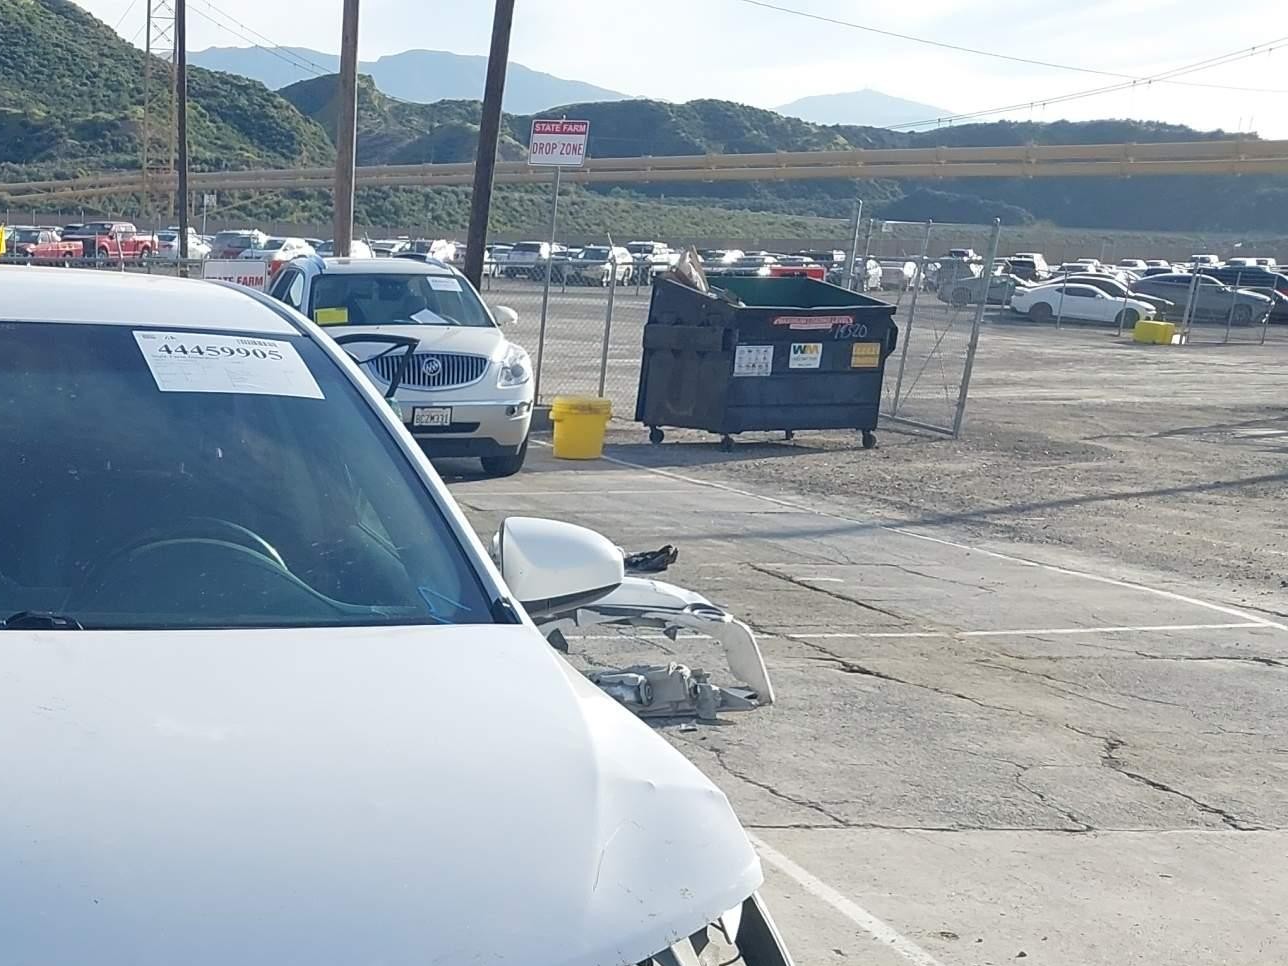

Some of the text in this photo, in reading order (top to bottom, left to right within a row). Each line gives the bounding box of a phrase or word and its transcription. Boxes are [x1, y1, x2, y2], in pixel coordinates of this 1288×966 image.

[535, 123, 586, 133] STATE FARM
[532, 142, 584, 156] DROP ZONE
[236, 276, 264, 287] FARM
[158, 343, 283, 361] 44459905
